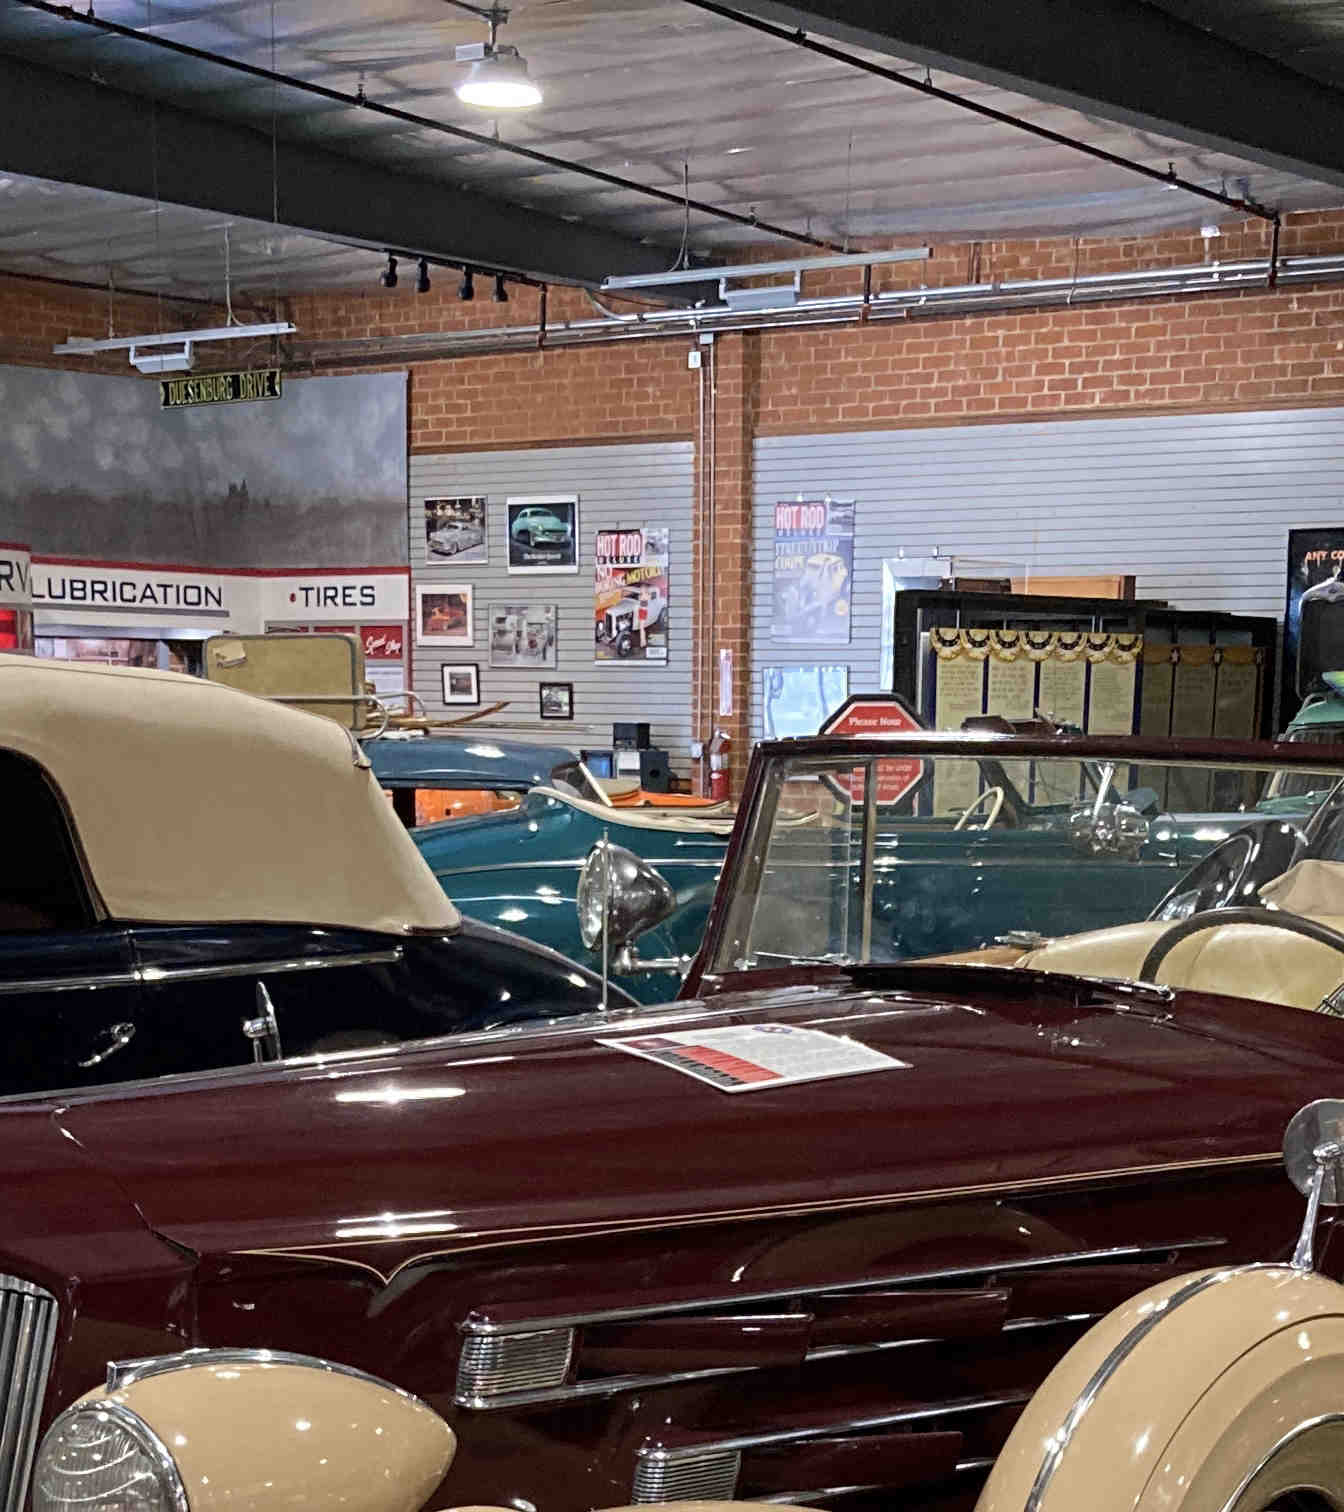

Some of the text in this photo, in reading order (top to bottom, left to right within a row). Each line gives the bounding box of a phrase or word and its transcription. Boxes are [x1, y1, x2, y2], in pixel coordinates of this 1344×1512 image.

[239, 373, 272, 400] DRIVE
[776, 505, 825, 529] HOT ROD
[597, 534, 641, 557] HOT ROD
[31, 575, 223, 607] LUBRICATION
